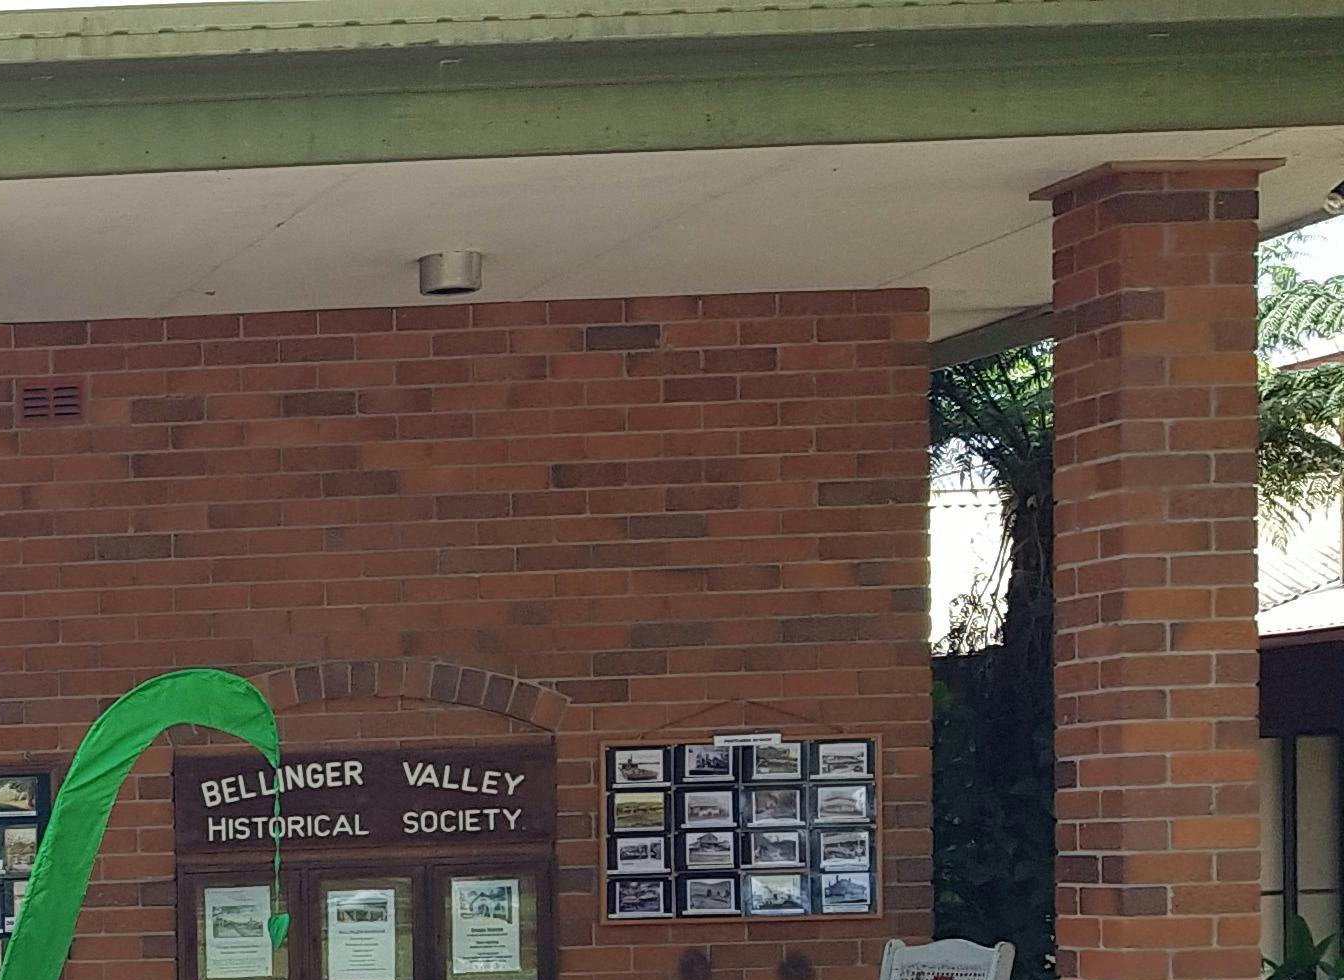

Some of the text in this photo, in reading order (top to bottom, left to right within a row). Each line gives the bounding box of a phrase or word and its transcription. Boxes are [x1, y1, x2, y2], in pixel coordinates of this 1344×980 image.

[200, 760, 526, 808] BELLINGER VALLEY
[207, 813, 370, 842] HISTORICAL
